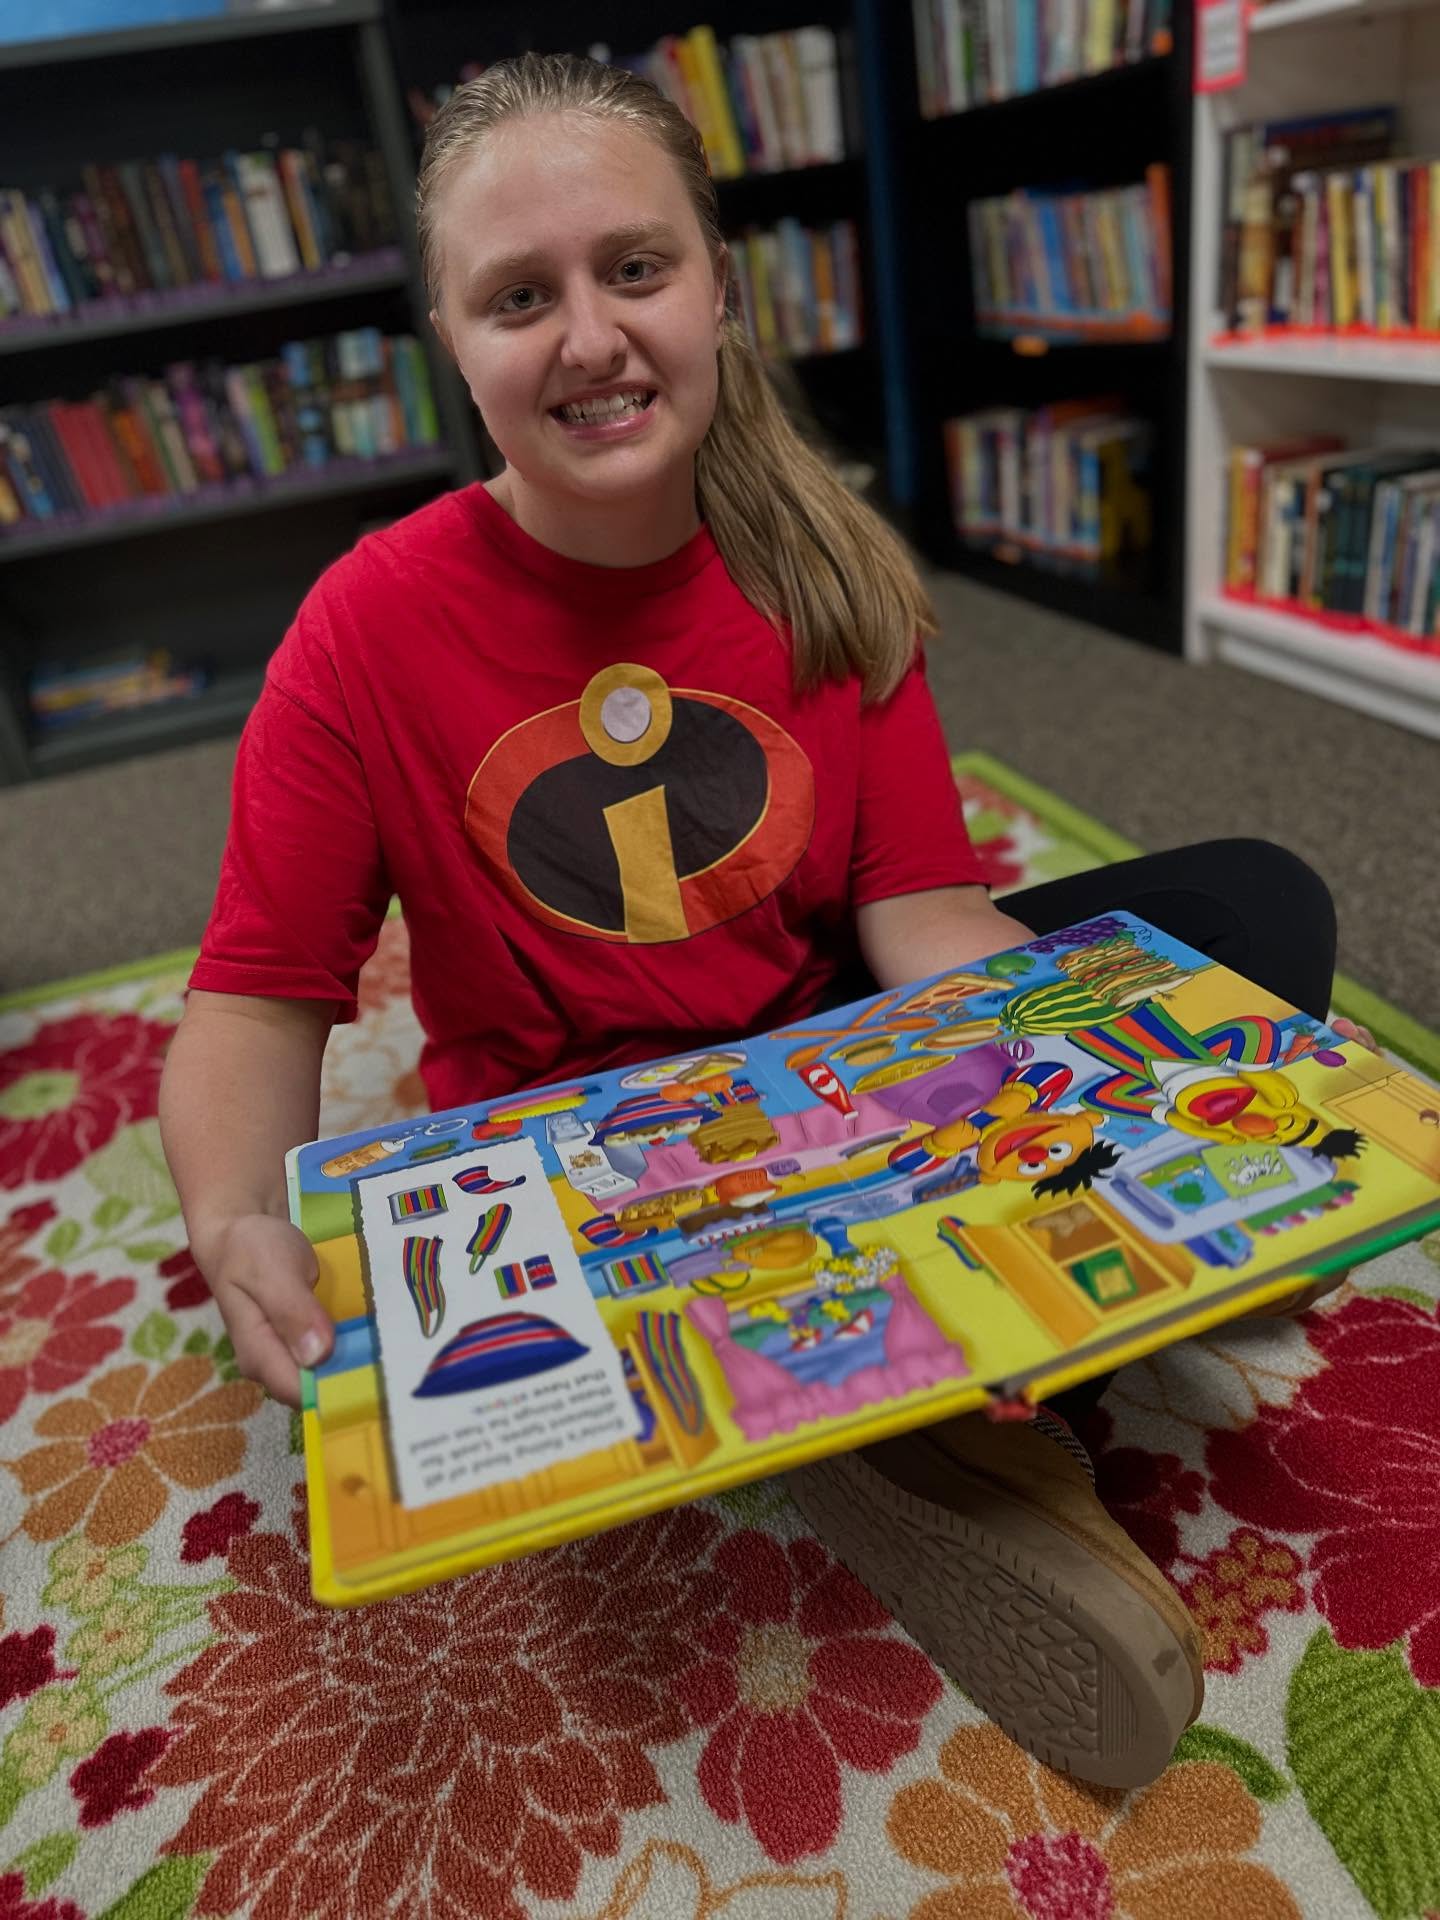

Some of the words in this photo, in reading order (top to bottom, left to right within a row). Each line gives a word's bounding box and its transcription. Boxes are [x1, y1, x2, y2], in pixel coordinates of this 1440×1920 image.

[583, 1176, 625, 1194] MILK
[574, 1369, 606, 1386] that
[534, 1380, 570, 1398] have
[569, 1386, 611, 1404] these
[514, 1400, 564, 1421] things
[549, 1402, 615, 1430] different
[455, 1425, 483, 1440] has
[490, 1418, 509, 1430] he
[451, 1441, 491, 1460] Look
[420, 1456, 444, 1469] for
